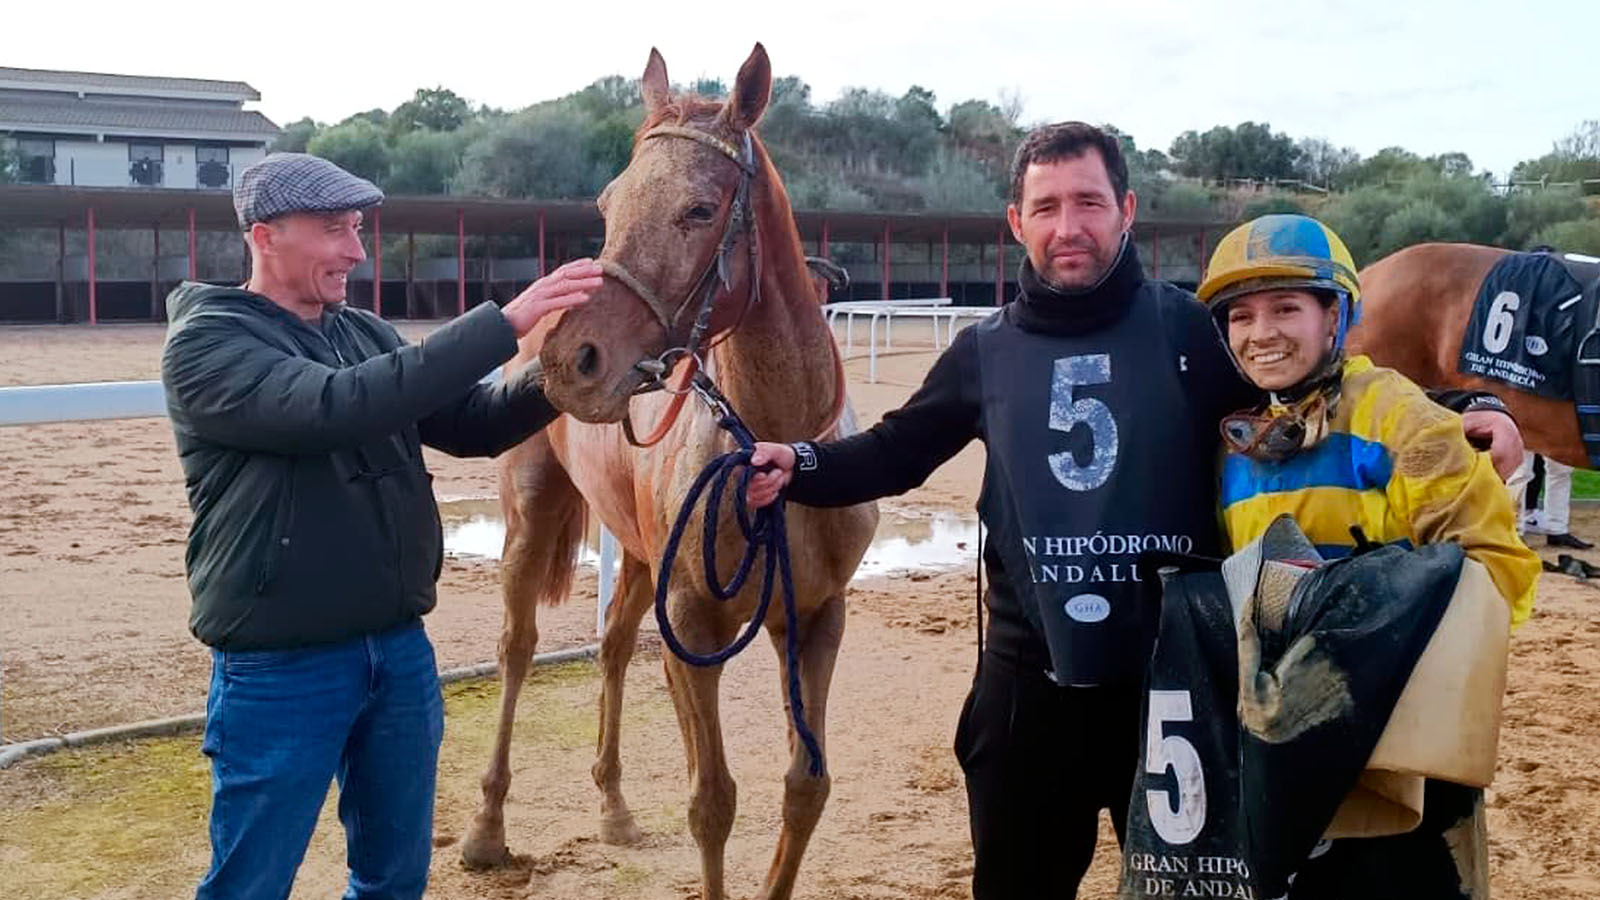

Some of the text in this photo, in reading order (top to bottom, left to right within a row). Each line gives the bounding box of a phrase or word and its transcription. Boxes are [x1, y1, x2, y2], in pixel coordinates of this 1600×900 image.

[1483, 291, 1520, 353] 6
[1470, 363, 1486, 374] DE
[1048, 353, 1119, 492] 5
[1044, 530, 1193, 556] HIPÓDROMO
[1145, 690, 1207, 845] 5
[1131, 853, 1188, 873] GRAN
[1145, 878, 1175, 896] DE
